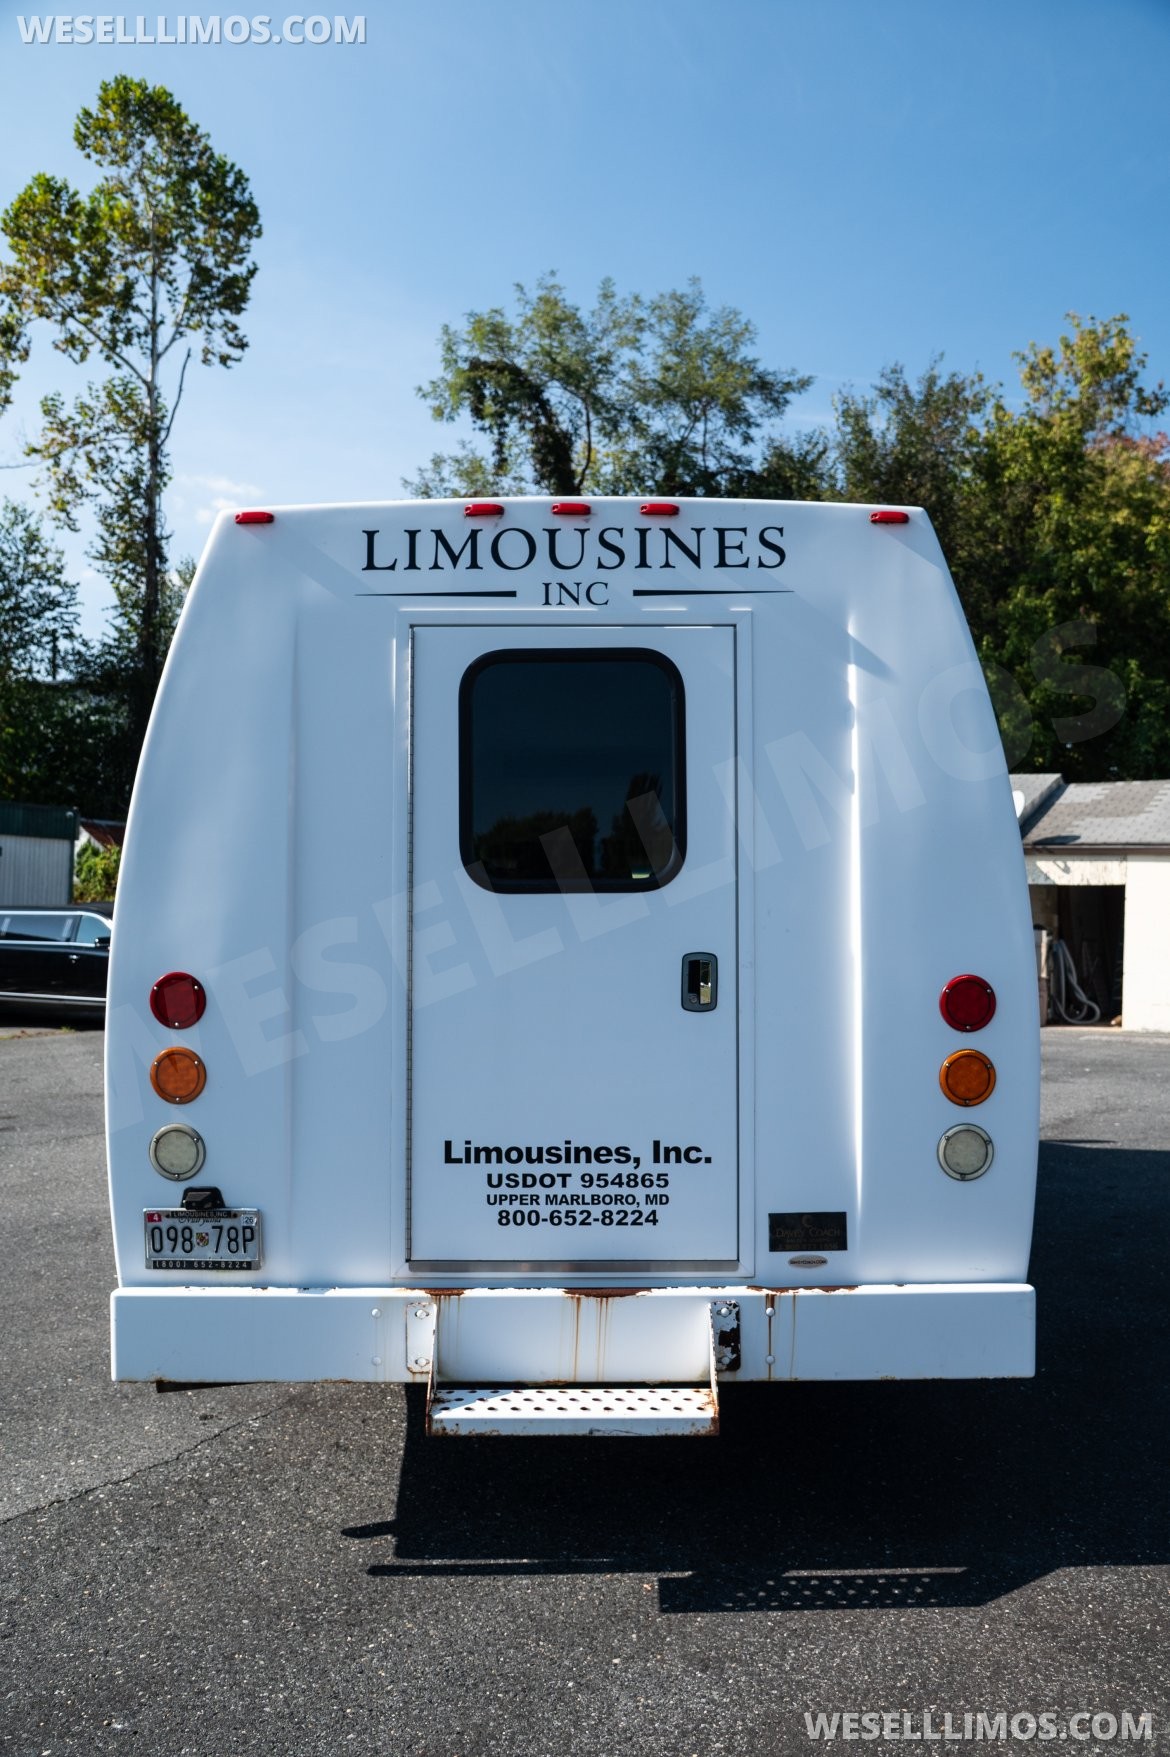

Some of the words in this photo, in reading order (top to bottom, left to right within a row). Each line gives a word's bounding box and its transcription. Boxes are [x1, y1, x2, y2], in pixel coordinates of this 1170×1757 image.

[361, 526, 786, 571] LIMOUSINES
[541, 581, 609, 606] INC
[444, 1140, 641, 1169] Limousines,
[652, 1140, 712, 1164] Inc.
[486, 1173, 572, 1188] USDOT
[580, 1173, 669, 1188] 954865
[486, 1194, 540, 1205] UPPER
[545, 1194, 640, 1207] MARLBORO,
[645, 1194, 669, 1205] MD
[497, 1209, 659, 1226] 800-652-8224
[151, 1226, 194, 1254] 098
[211, 1225, 255, 1254] 78P
